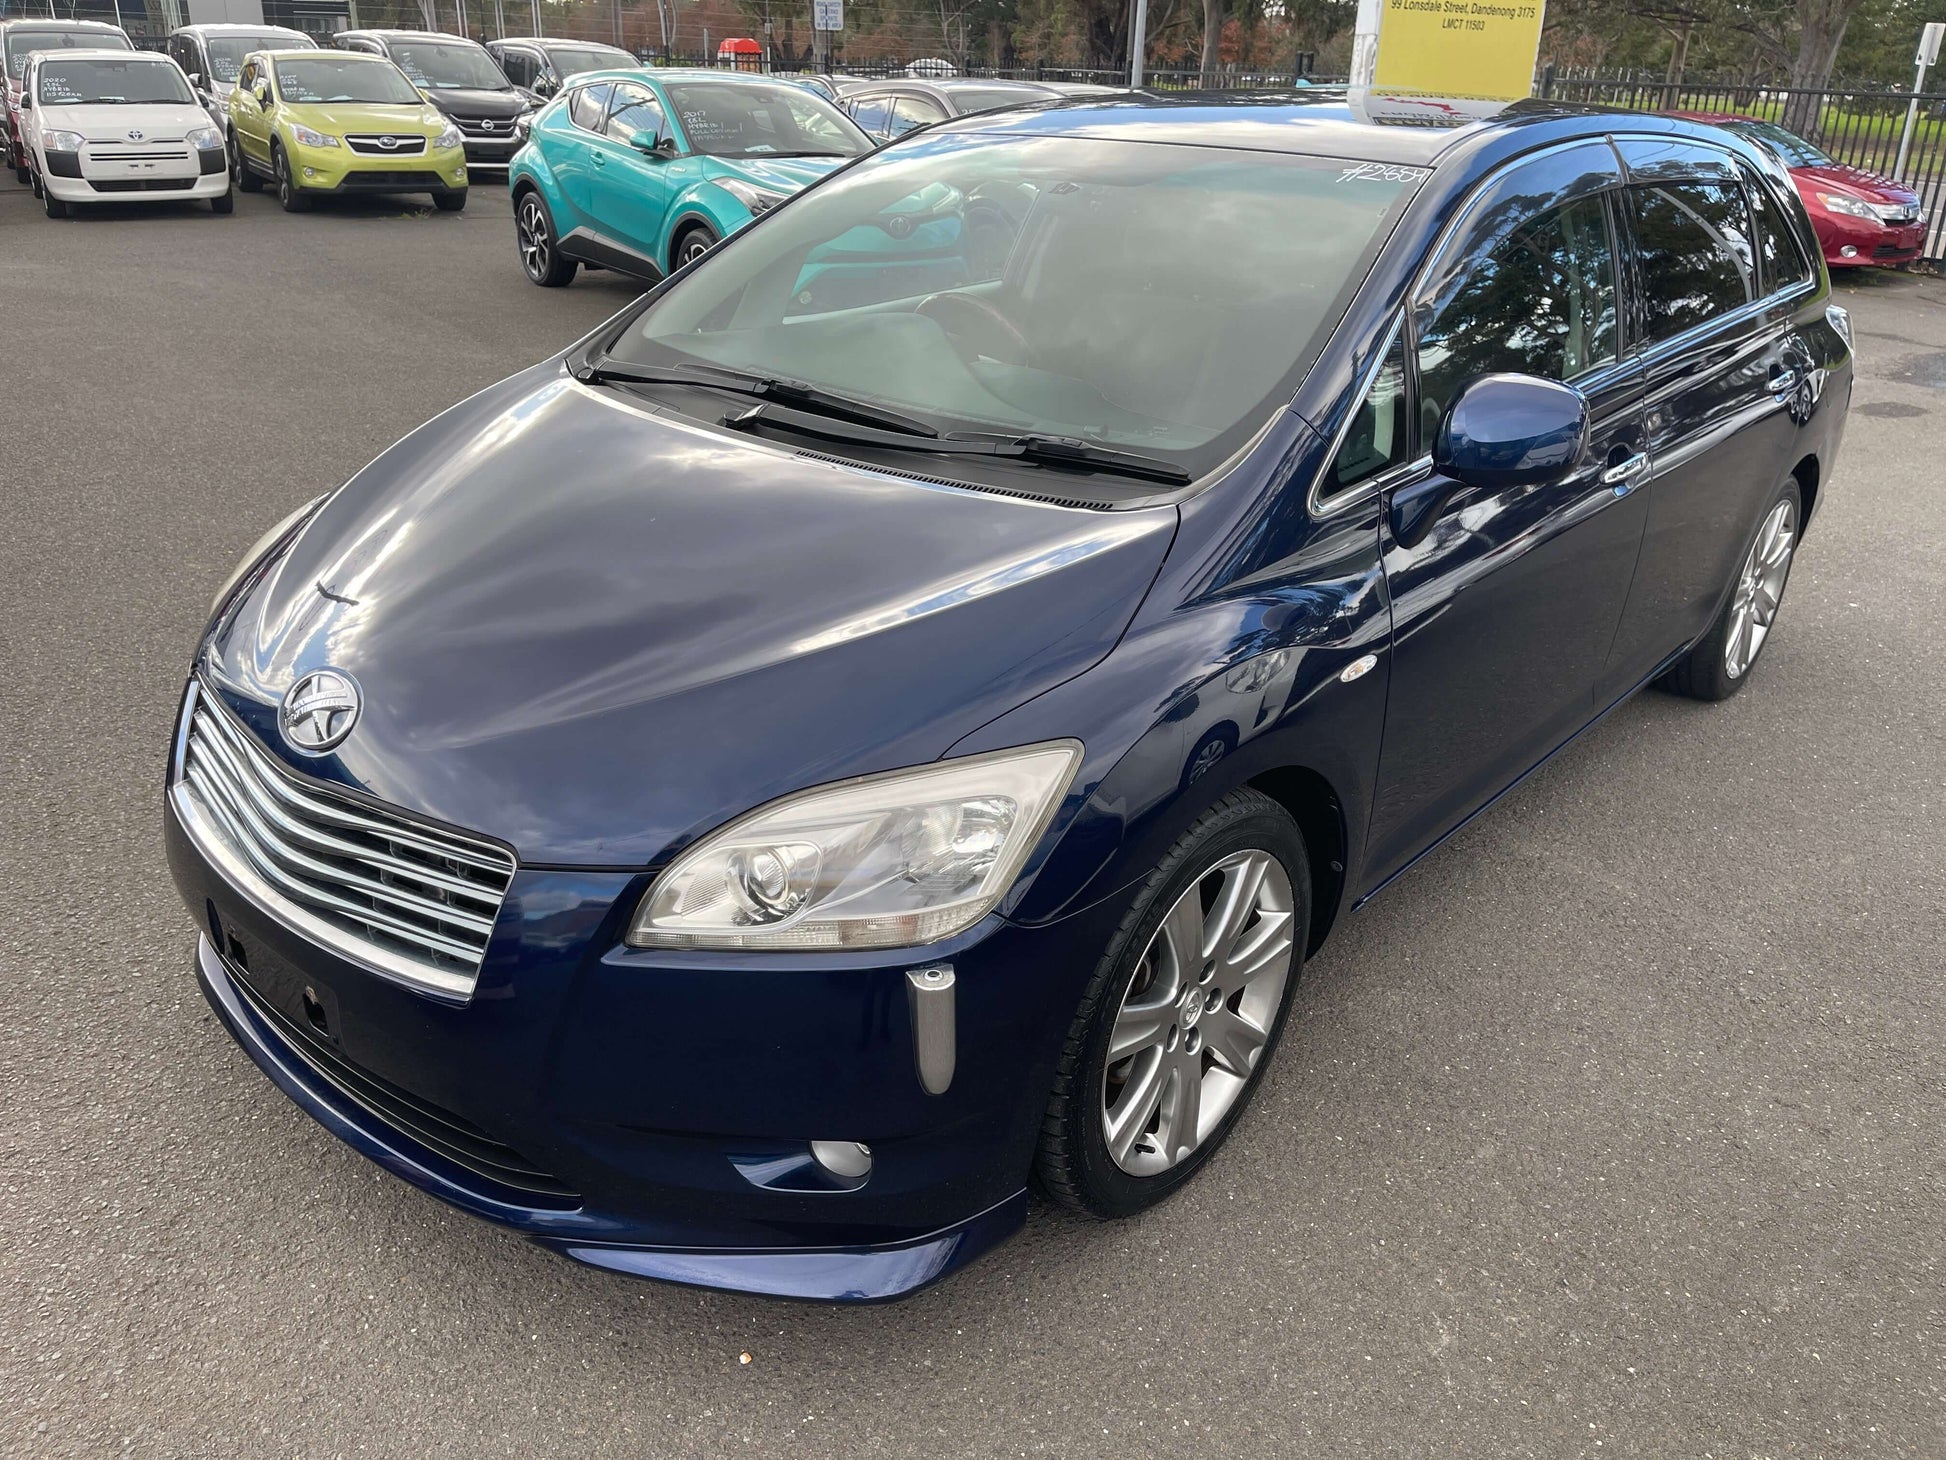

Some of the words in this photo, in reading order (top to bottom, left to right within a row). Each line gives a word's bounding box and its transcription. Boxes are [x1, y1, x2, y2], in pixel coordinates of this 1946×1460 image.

[1403, 0, 1441, 12] Lonsdale
[1443, 1, 1469, 14] Street,
[1471, 3, 1515, 20] Dandenong
[1517, 6, 1536, 18] 3175
[1442, 18, 1464, 30] LMCT
